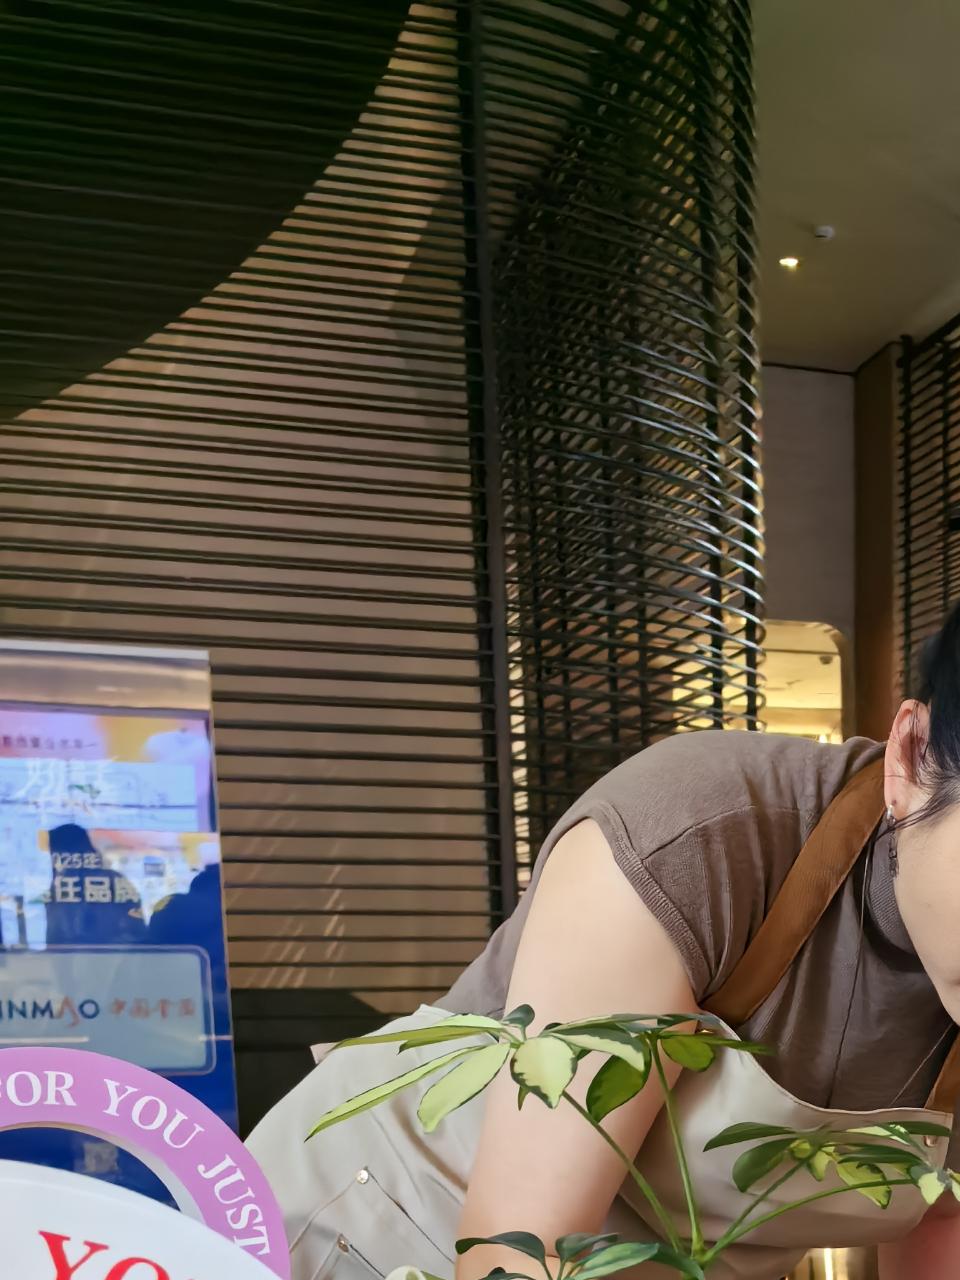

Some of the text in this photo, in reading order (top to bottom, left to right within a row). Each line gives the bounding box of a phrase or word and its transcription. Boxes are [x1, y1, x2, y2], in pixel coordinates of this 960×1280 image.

[0, 1070, 77, 1106] OR
[103, 1079, 205, 1149] YOU
[197, 1154, 270, 1257] JUST
